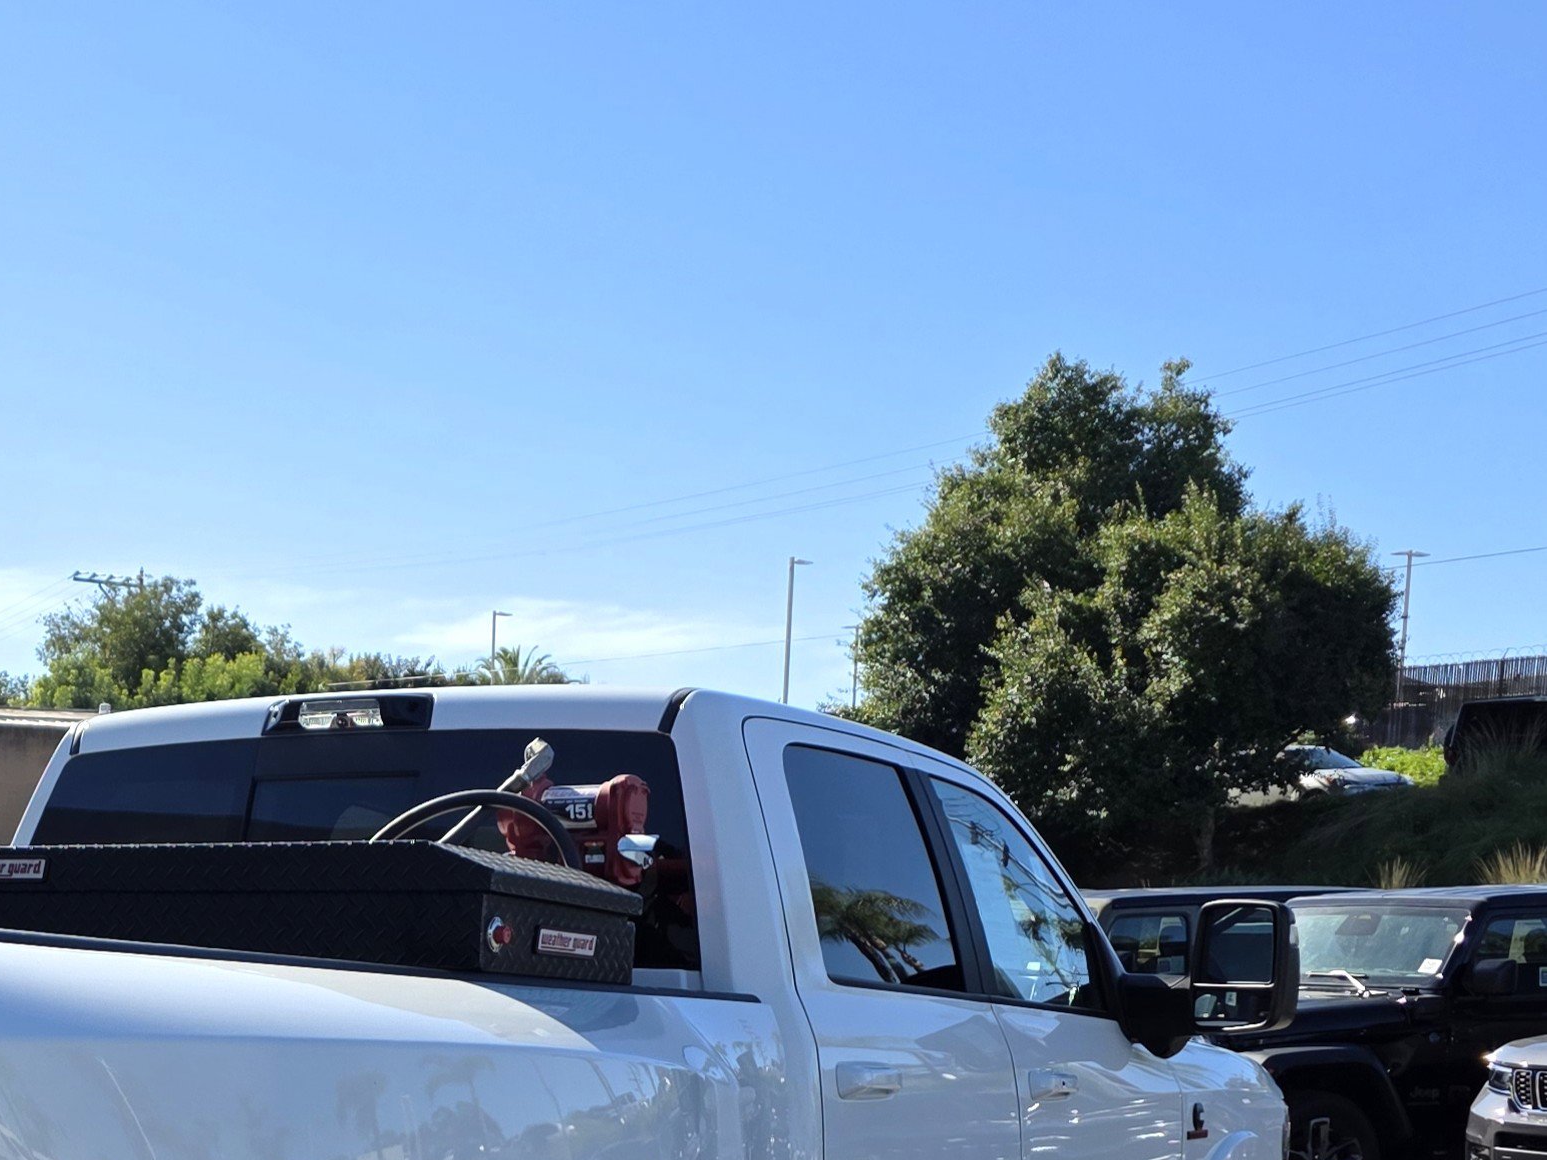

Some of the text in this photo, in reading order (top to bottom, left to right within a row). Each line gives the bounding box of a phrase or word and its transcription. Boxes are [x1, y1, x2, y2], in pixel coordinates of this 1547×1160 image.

[8, 861, 41, 876] guard
[541, 932, 595, 951] weather guard
